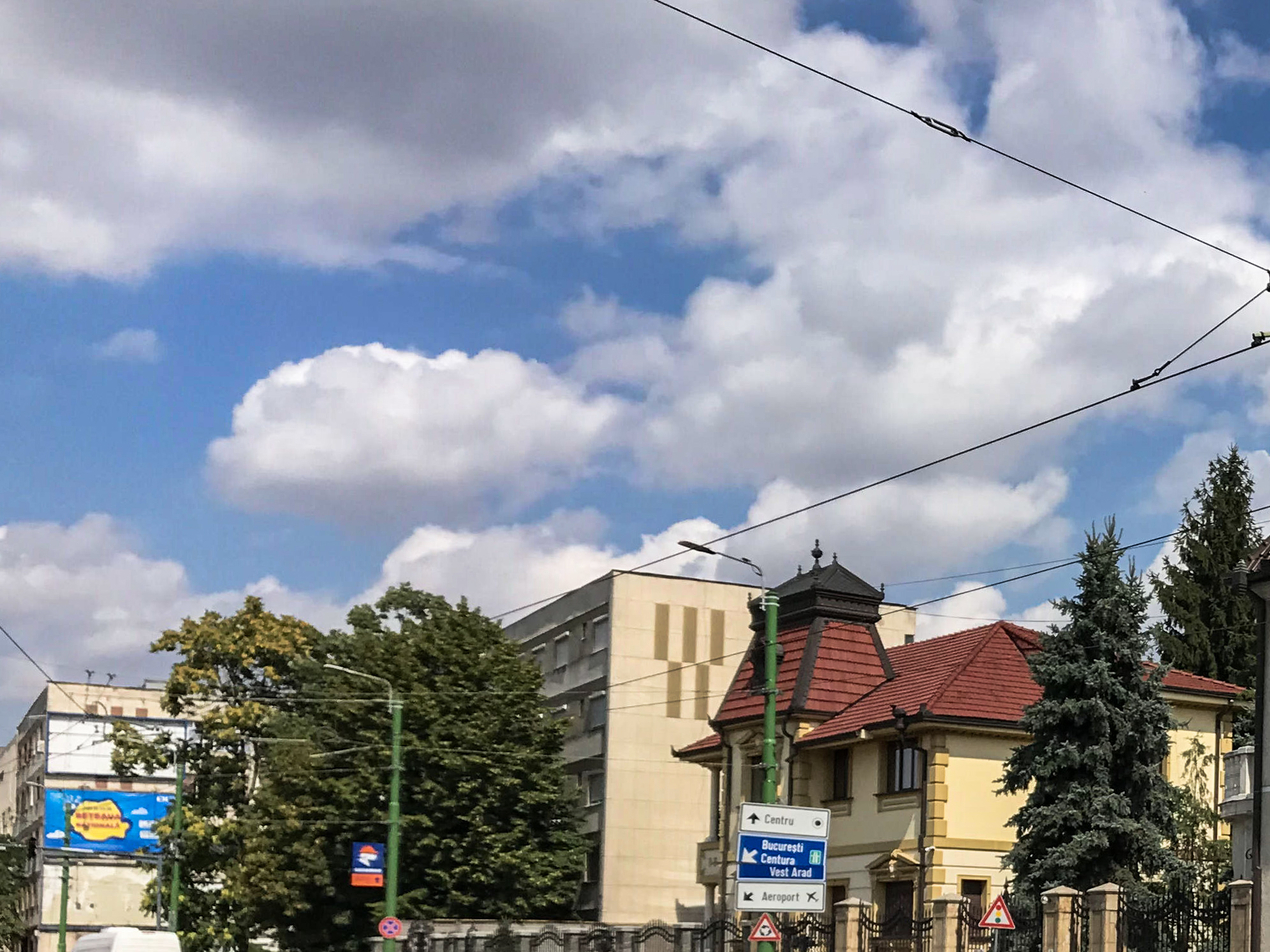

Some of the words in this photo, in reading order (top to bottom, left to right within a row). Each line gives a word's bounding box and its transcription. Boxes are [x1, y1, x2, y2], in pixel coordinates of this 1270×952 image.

[765, 814, 794, 826] Centru
[762, 840, 804, 853] București
[761, 853, 796, 865] Centura
[770, 866, 789, 877] Vest
[791, 867, 812, 878] Arad
[762, 891, 800, 903] Aeroport
